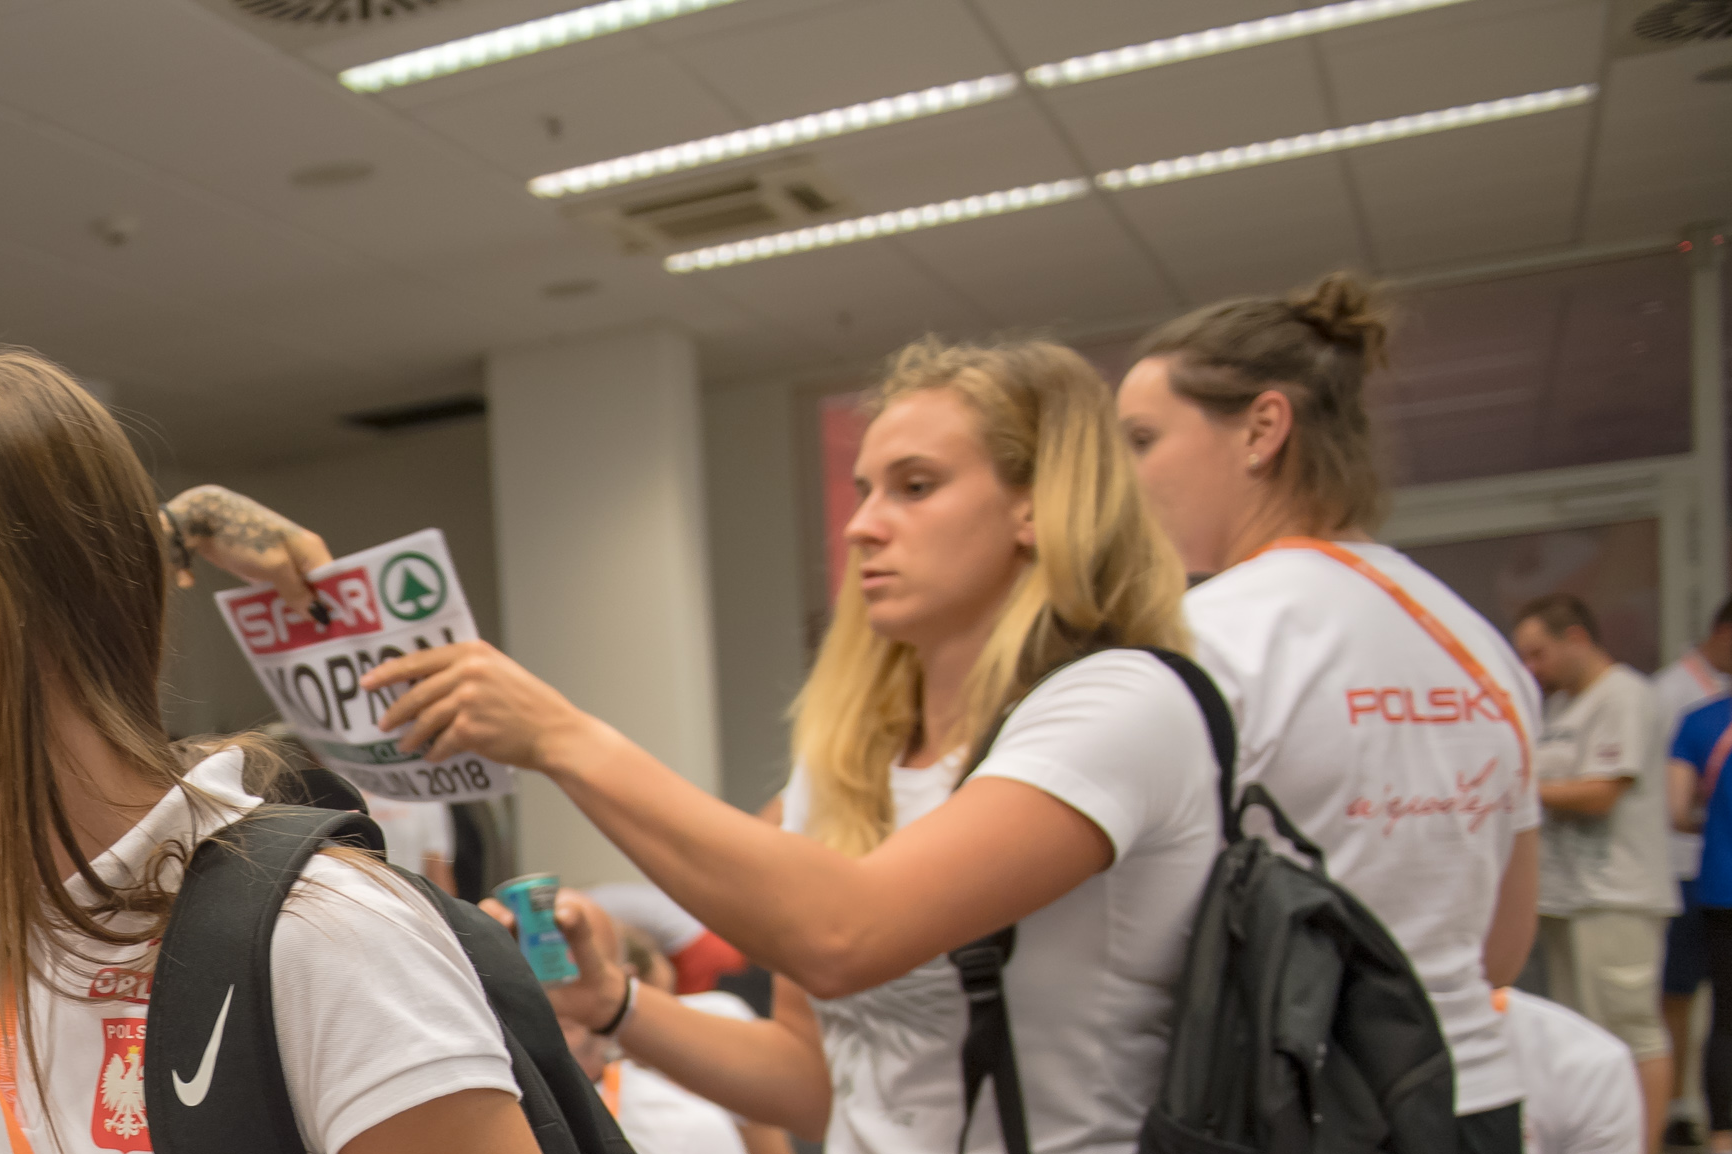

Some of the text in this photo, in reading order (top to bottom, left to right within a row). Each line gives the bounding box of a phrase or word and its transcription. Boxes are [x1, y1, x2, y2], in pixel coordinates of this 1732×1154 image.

[1346, 687, 1509, 725] POLSK
[418, 760, 490, 796] 2018
[95, 971, 152, 1000] ORL
[106, 1024, 147, 1040] POLS
